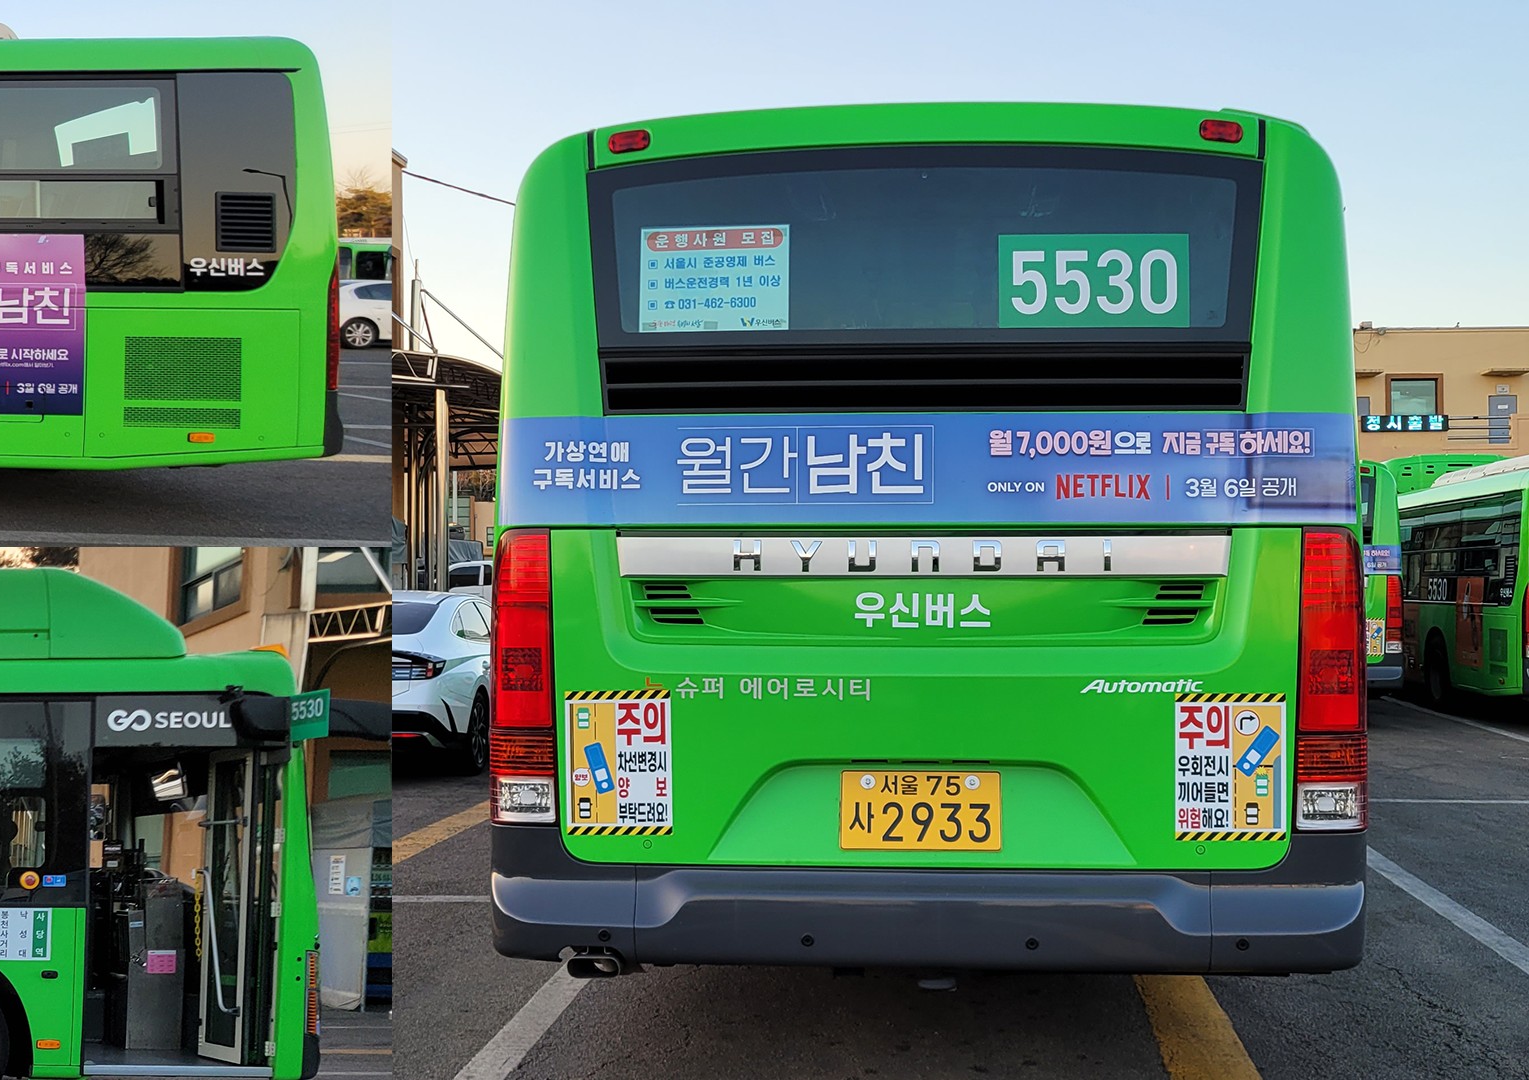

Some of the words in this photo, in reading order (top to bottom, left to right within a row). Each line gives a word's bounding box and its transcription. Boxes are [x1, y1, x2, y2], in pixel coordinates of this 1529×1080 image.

[655, 231, 727, 248] 운행사원
[741, 230, 774, 245] 모집
[189, 257, 264, 276] 우신버스
[664, 258, 697, 269] 서울시
[703, 256, 747, 268] 준공영제
[754, 255, 776, 267] 버스
[665, 276, 730, 290] 버스운전경력
[736, 276, 753, 287] 1년
[759, 275, 781, 287] 이상
[1011, 249, 1178, 315] 5530
[678, 297, 756, 310] 031-462-6300
[11, 348, 69, 361] 시작하세요
[16, 383, 35, 394] 3월
[37, 383, 55, 394] 6일
[58, 383, 78, 394] 공개
[544, 441, 630, 464] 가상연애
[989, 430, 1012, 456] 월
[1016, 430, 1152, 459] 7,000원으로
[1162, 431, 1202, 456] 지금
[1205, 431, 1235, 456] 구독
[676, 432, 924, 495] 월간남친
[533, 468, 641, 491] 구독서비스
[987, 481, 1022, 493] ONLY
[1025, 481, 1045, 493] ON
[1056, 474, 1151, 500] NETFLIX
[1185, 478, 1217, 498] 3월
[1223, 478, 1257, 498] 6일
[1261, 477, 1297, 497] 공개
[732, 539, 1112, 572] HYUNDAI
[1428, 578, 1448, 601] 5530
[854, 591, 991, 628] 우신버스
[675, 677, 724, 700] 슈퍼
[740, 677, 872, 701] 에어로시티
[1080, 679, 1204, 694] Automatic
[154, 711, 232, 729] SEOUL
[291, 698, 323, 720] 5530
[617, 702, 667, 746] 주의
[1178, 705, 1230, 749] 주의
[618, 751, 667, 772] 차선변경시
[1178, 755, 1229, 777] 우회전시
[880, 775, 918, 795] 서울
[926, 776, 961, 796] 75
[1178, 782, 1229, 803] 끼어들면
[619, 802, 668, 823] 부탁드려요!
[1178, 807, 1229, 829] 위험해요!
[0, 910, 9, 957] 봉천사거리
[18, 911, 28, 957] 낙성대
[35, 913, 45, 956] 사당역
